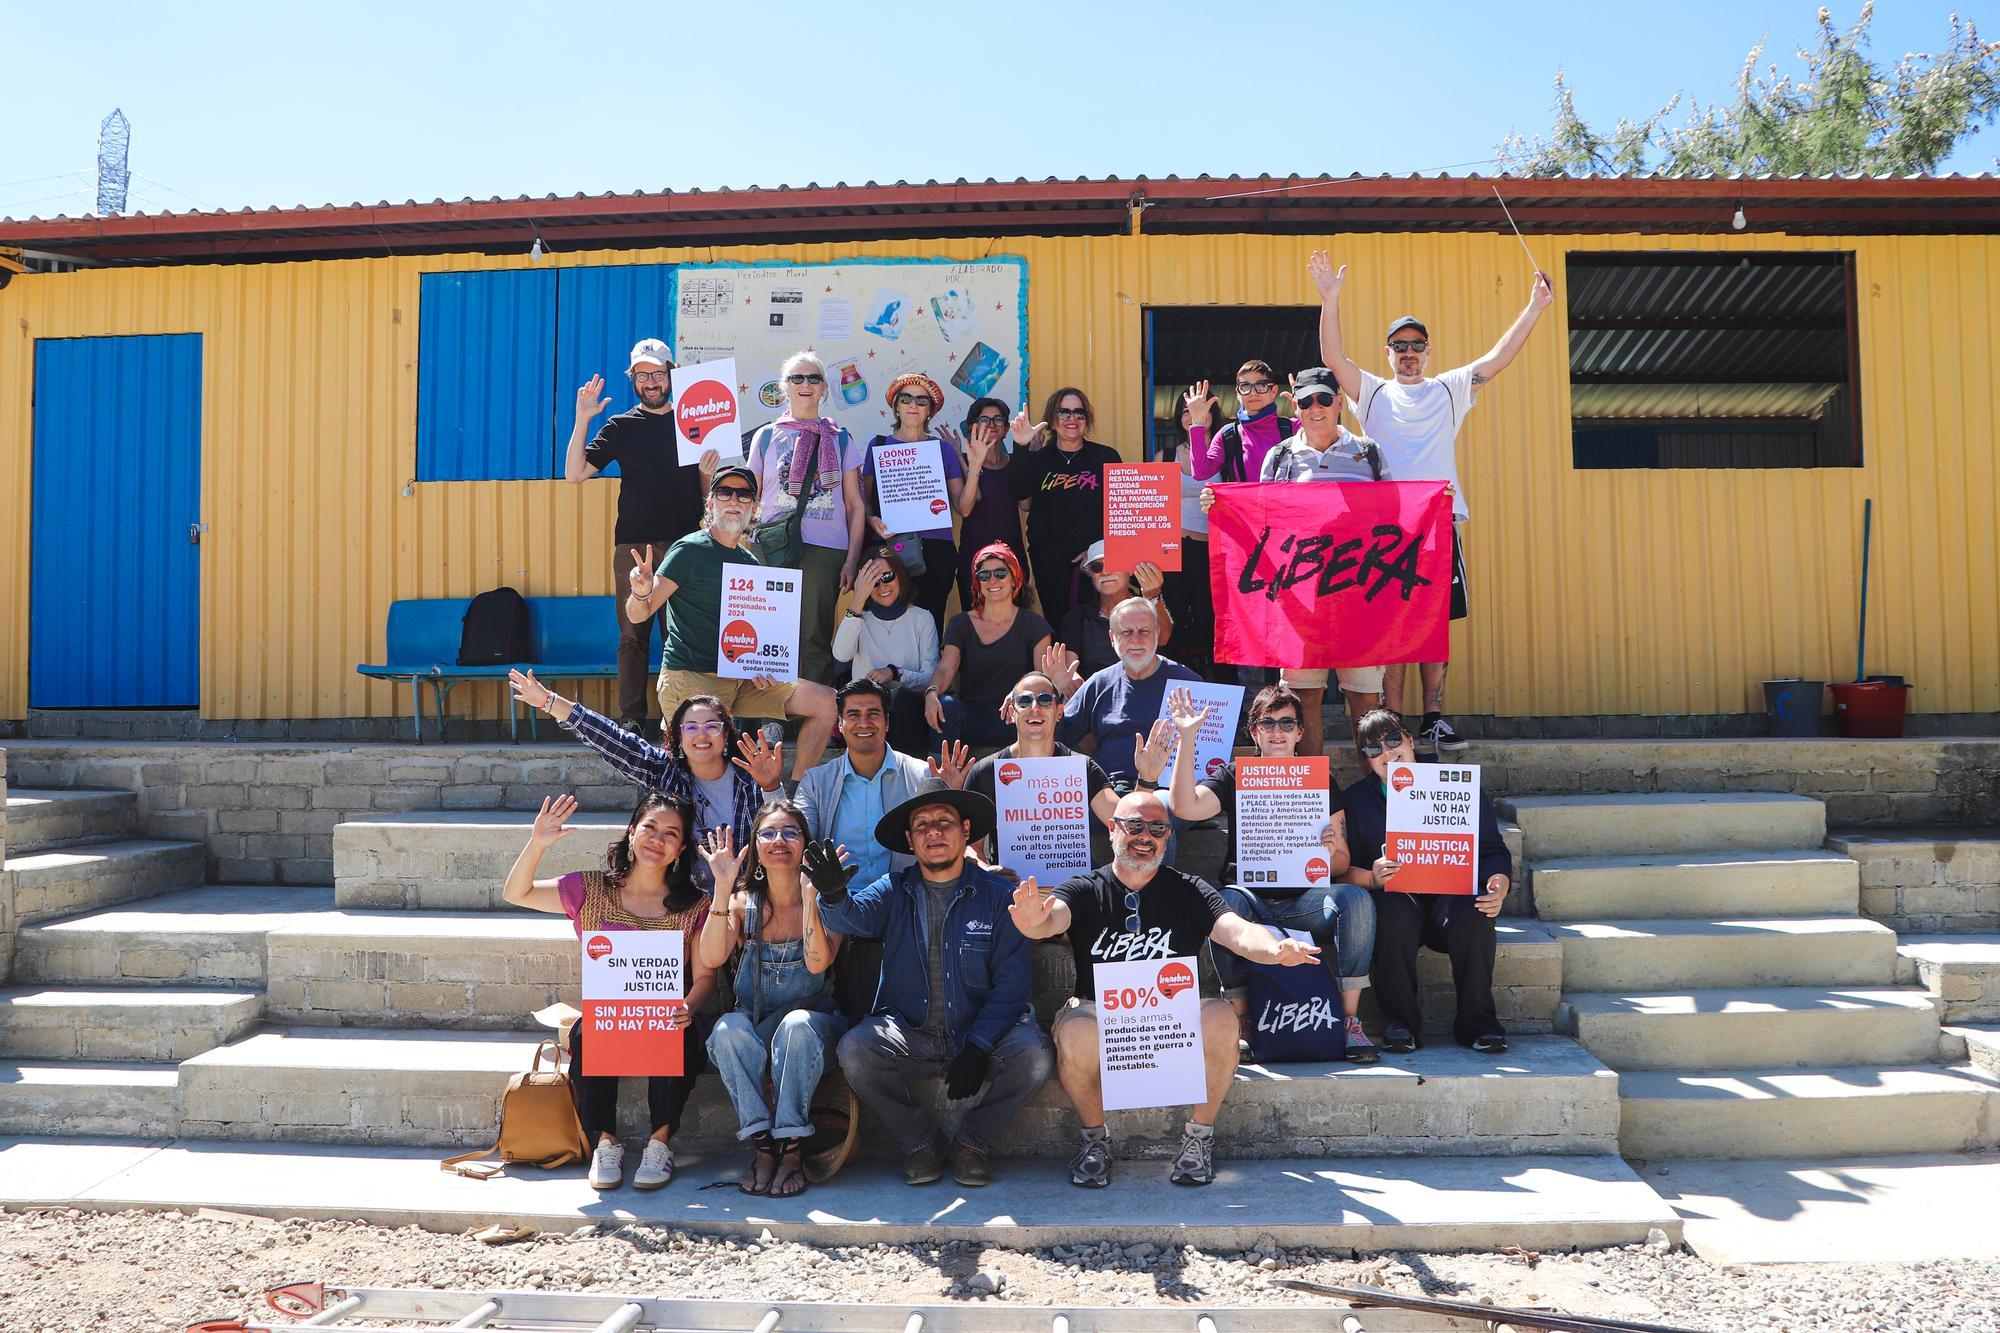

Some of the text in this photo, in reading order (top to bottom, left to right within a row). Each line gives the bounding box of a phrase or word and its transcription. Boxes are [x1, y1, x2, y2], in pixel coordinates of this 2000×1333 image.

[786, 269, 807, 277] Mural
[951, 265, 1003, 274] ELABORADO
[681, 398, 730, 419] hambre
[729, 578, 754, 591] 124
[729, 594, 766, 602] periodistas
[728, 603, 766, 611] asesinados
[763, 644, 789, 658] 85%
[1242, 766, 1310, 775] JUSTICIA QUE
[1028, 775, 1059, 789] más
[1065, 775, 1082, 787] de
[1242, 778, 1303, 787] CONSTRUYE
[1038, 791, 1083, 804] 6.000
[1410, 790, 1471, 801] SIN VERDAD
[1005, 806, 1084, 821] MILLONES
[1433, 804, 1471, 813] NO HAY
[1423, 816, 1470, 825] JUSTICIA.
[1045, 823, 1085, 832] personas
[1057, 832, 1085, 842] países
[1055, 841, 1086, 849] niveles
[1397, 839, 1470, 852] SIN JUSTICIA
[1025, 850, 1086, 860] de corrupción
[1397, 853, 1470, 866] NO HAY PAZ.
[1046, 860, 1087, 870] percibida
[608, 958, 678, 967] SIN VERDAD
[636, 970, 678, 979] NO HAY
[624, 982, 678, 992] JUSTICIA.
[1103, 987, 1159, 1010] 50%
[595, 1006, 616, 1017] SIN
[1104, 1013, 1174, 1025] de las armas
[595, 1020, 614, 1030] NO
[618, 1020, 644, 1030] HAY
[1105, 1025, 1156, 1036] producidas
[1105, 1035, 1136, 1044] mundo
[1140, 1034, 1150, 1042] se
[1154, 1032, 1187, 1041] venden
[1106, 1044, 1136, 1054] países
[1139, 1043, 1151, 1051] en
[1154, 1042, 1184, 1052] guerra
[1107, 1053, 1154, 1062] altamente
[1107, 1061, 1159, 1071] inestables.
